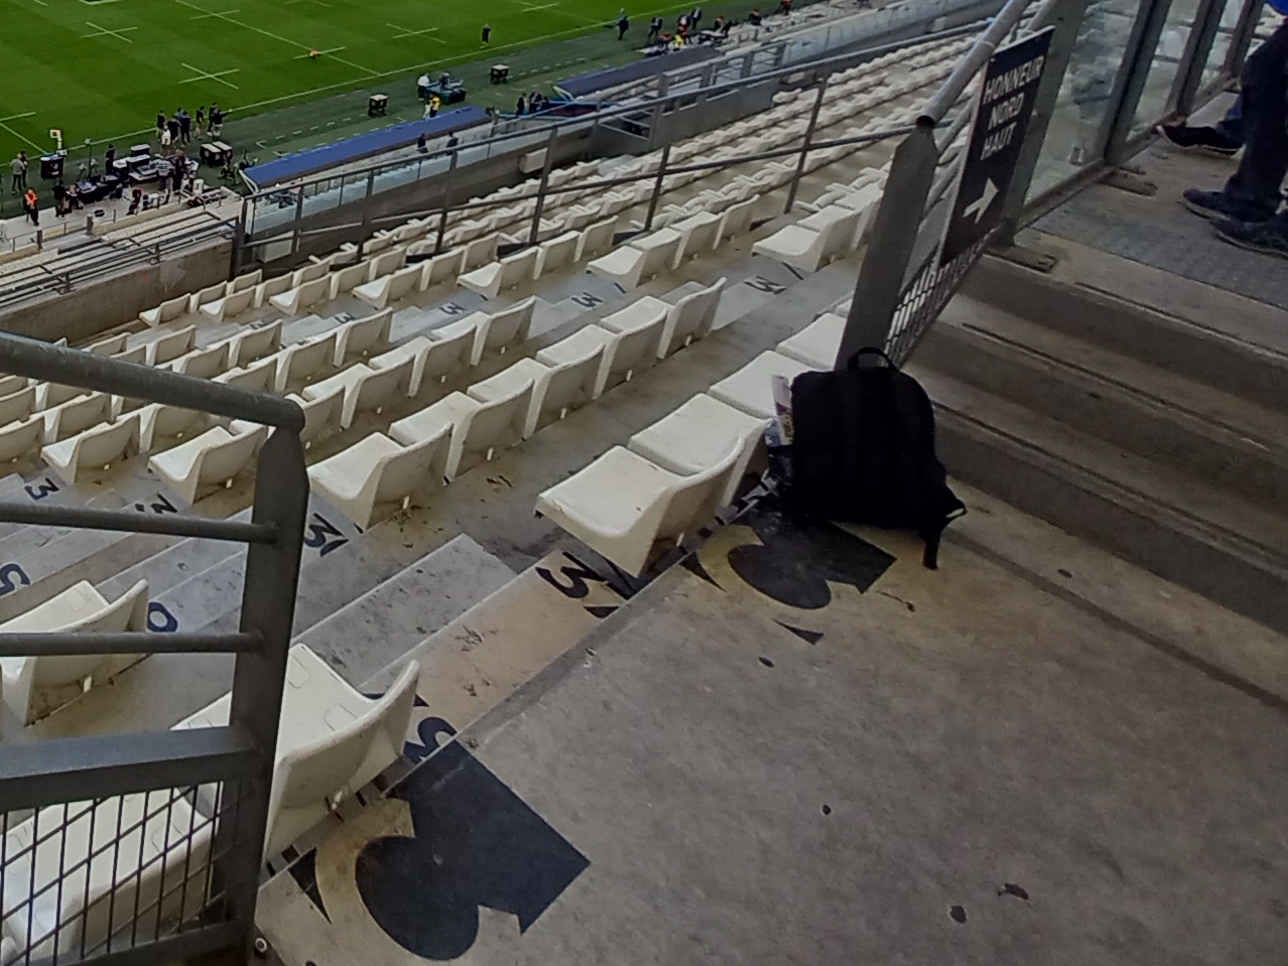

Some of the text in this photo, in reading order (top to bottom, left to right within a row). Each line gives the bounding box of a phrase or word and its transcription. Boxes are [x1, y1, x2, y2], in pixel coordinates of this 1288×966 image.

[982, 55, 1045, 105] HONNEUR
[987, 92, 1025, 131] NORD
[979, 121, 1017, 161] HAUT
